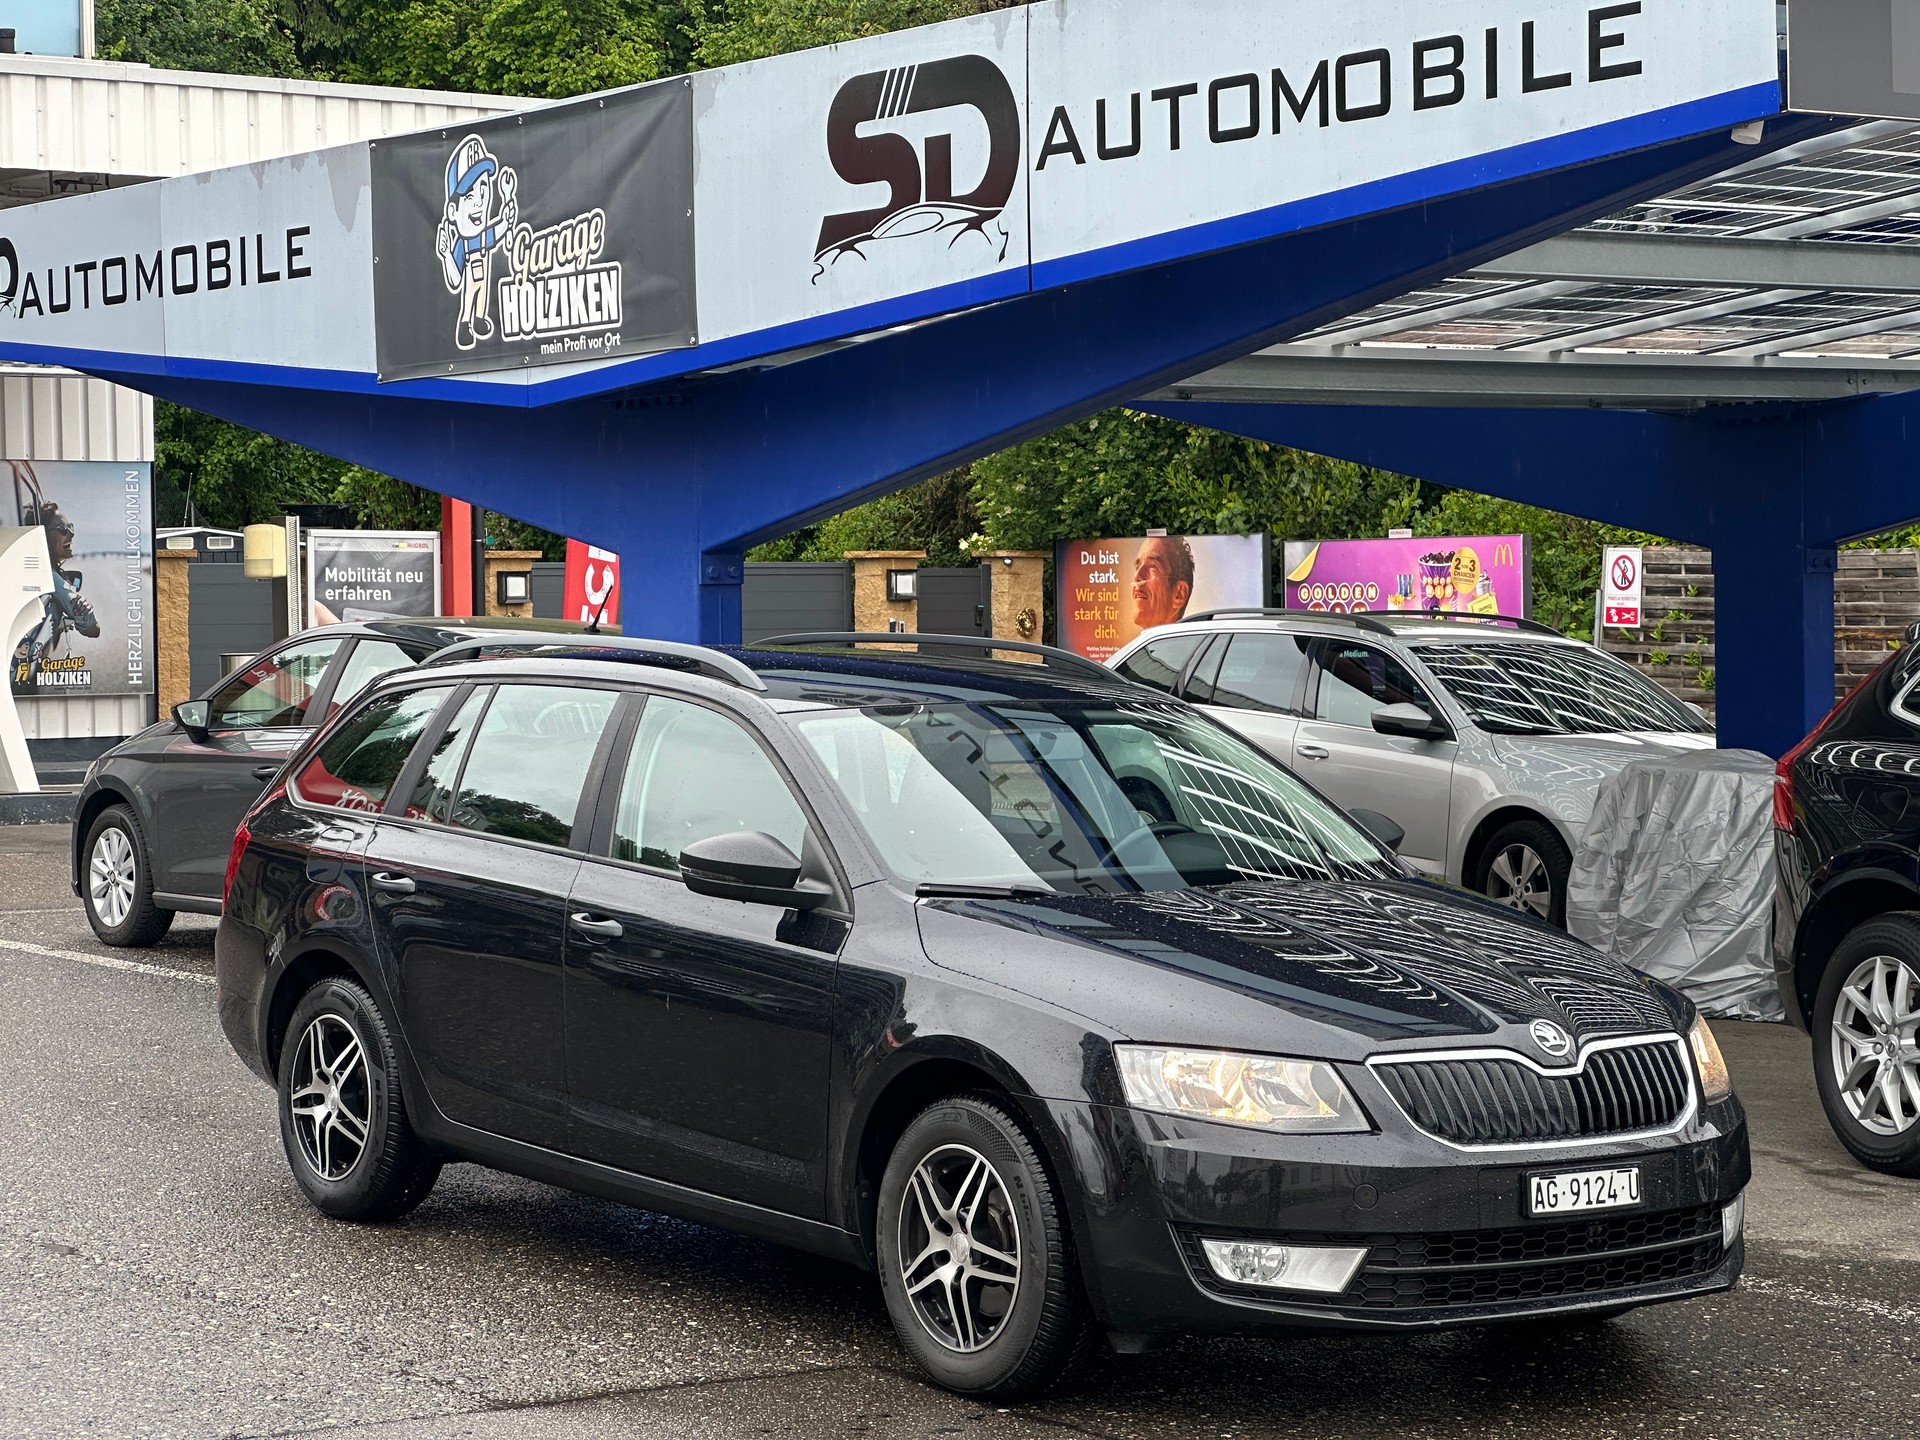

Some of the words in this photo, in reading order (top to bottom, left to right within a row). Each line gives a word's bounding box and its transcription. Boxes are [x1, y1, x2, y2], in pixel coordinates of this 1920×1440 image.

[1035, 1, 1642, 171] AUTOMOBILE
[511, 211, 602, 288] Garage
[19, 226, 311, 319] AUTOMOBILE
[501, 269, 619, 334] HOLZIKEN
[540, 339, 563, 355] mein
[564, 335, 586, 352] Profi
[588, 337, 603, 349] vor
[604, 332, 621, 347] Ort
[124, 470, 142, 595] WILLKOMMEN
[1080, 551, 1096, 565] Du
[1099, 550, 1119, 565] bist
[1454, 557, 1461, 570] 2
[1469, 560, 1476, 572] 3
[325, 566, 392, 583] Mobilität
[395, 571, 424, 583] neu
[1089, 568, 1119, 583] stark.
[325, 585, 392, 601] erfahren
[1075, 588, 1095, 602] Wir
[1097, 588, 1119, 602] sind
[1299, 585, 1378, 602] GOLDEN
[1074, 606, 1101, 621] stark
[1104, 605, 1119, 621] für
[1094, 624, 1119, 639] dich.
[127, 598, 143, 685] HERZLICH
[41, 656, 85, 672] Garage
[36, 671, 91, 686] HOLZIKEN
